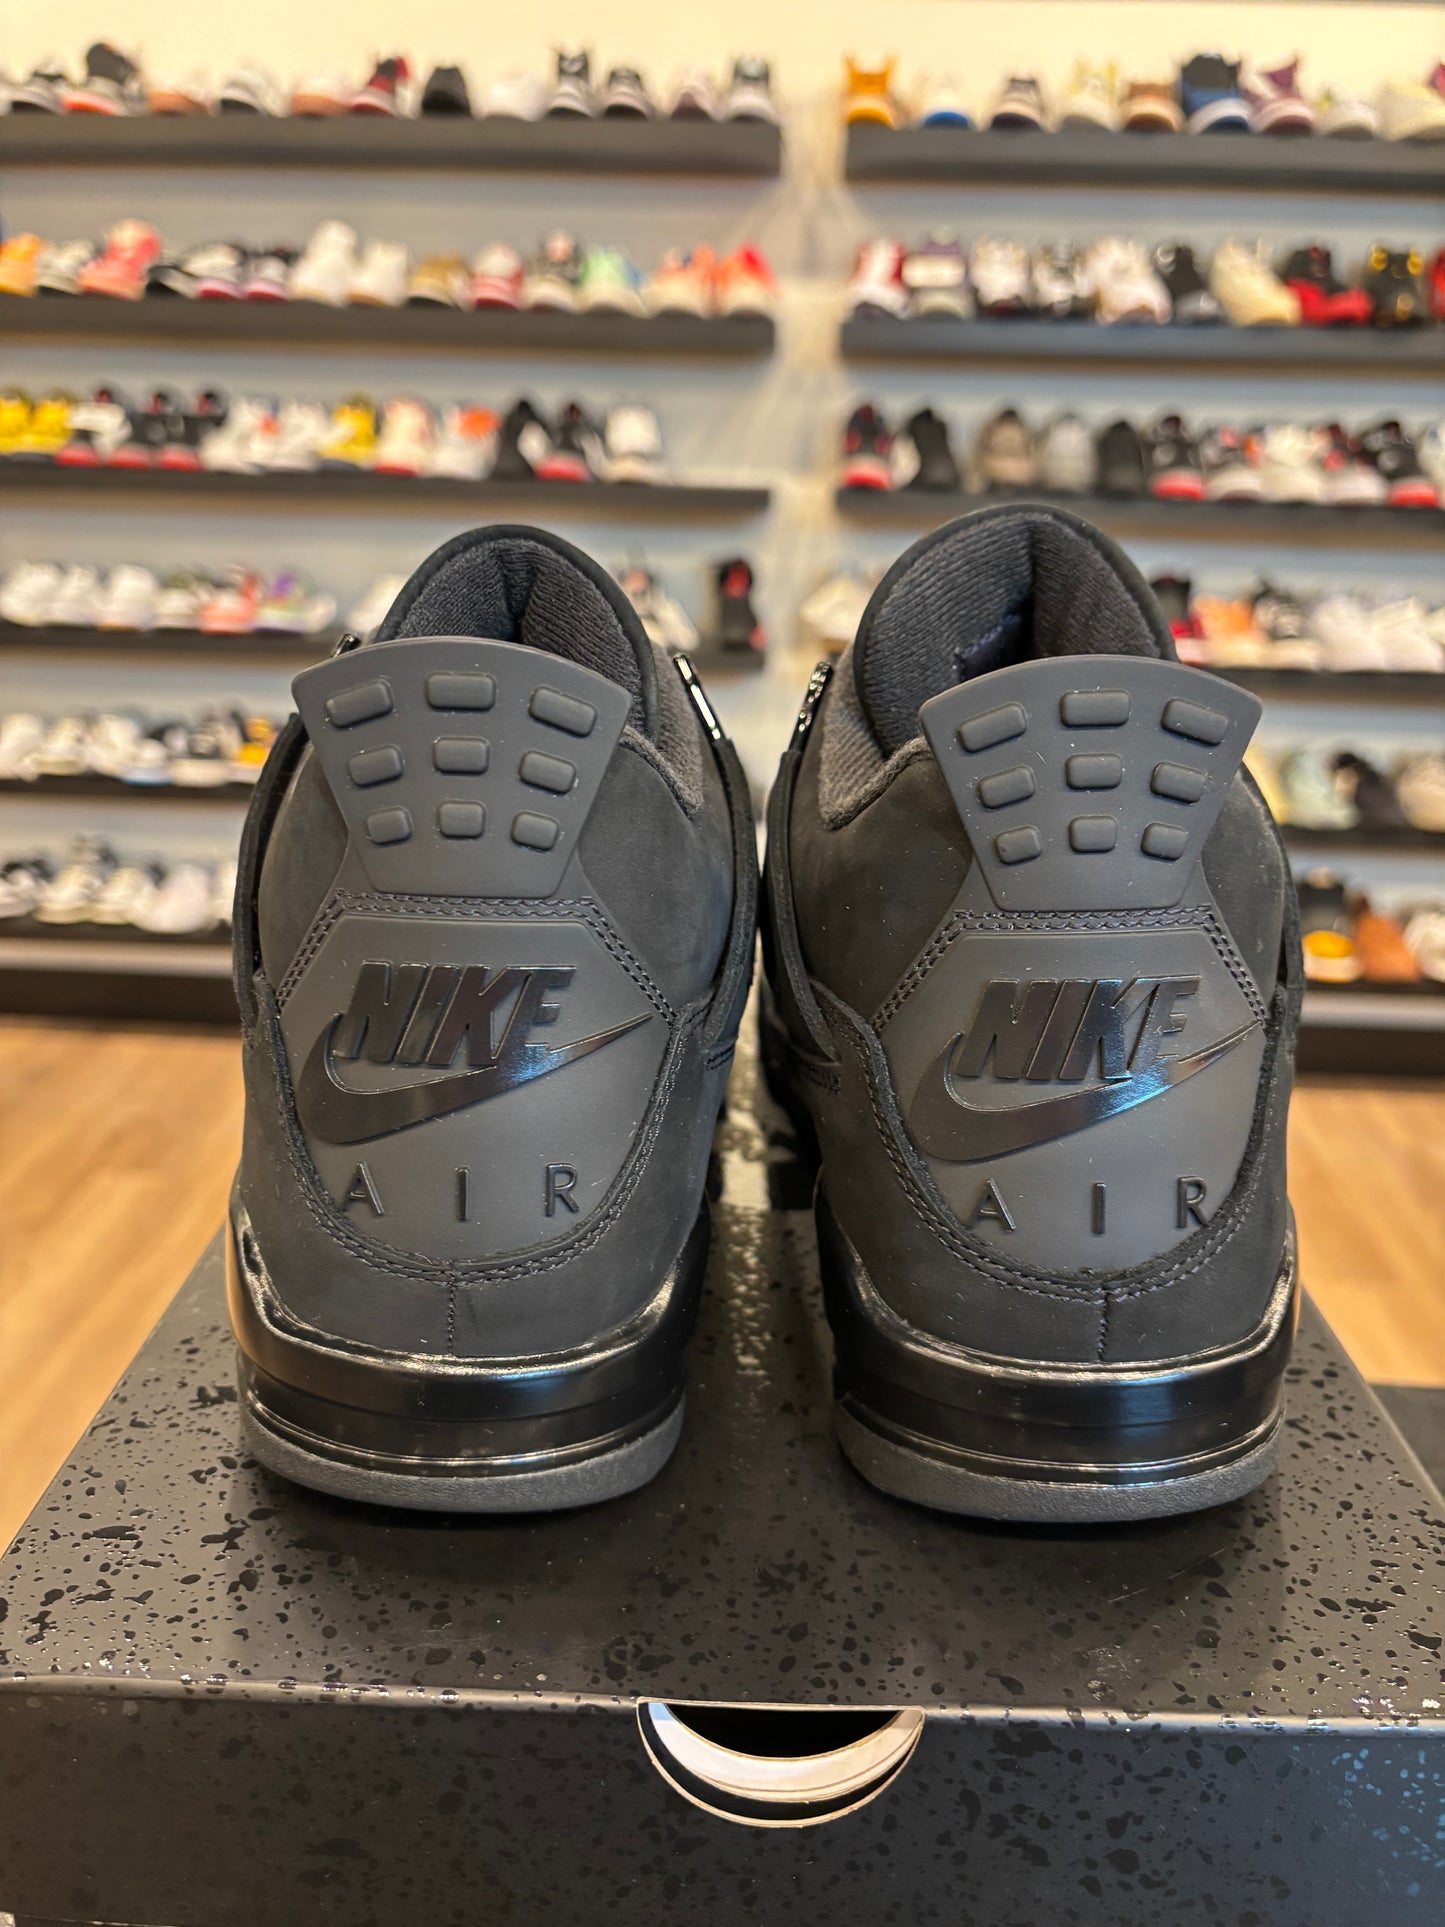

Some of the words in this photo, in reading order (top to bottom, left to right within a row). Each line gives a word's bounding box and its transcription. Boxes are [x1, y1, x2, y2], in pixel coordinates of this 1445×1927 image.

[333, 960, 577, 1067] NIKE
[953, 974, 1202, 1081] NIKE
[342, 1160, 580, 1222] AIR
[968, 1174, 1209, 1235] AIR
